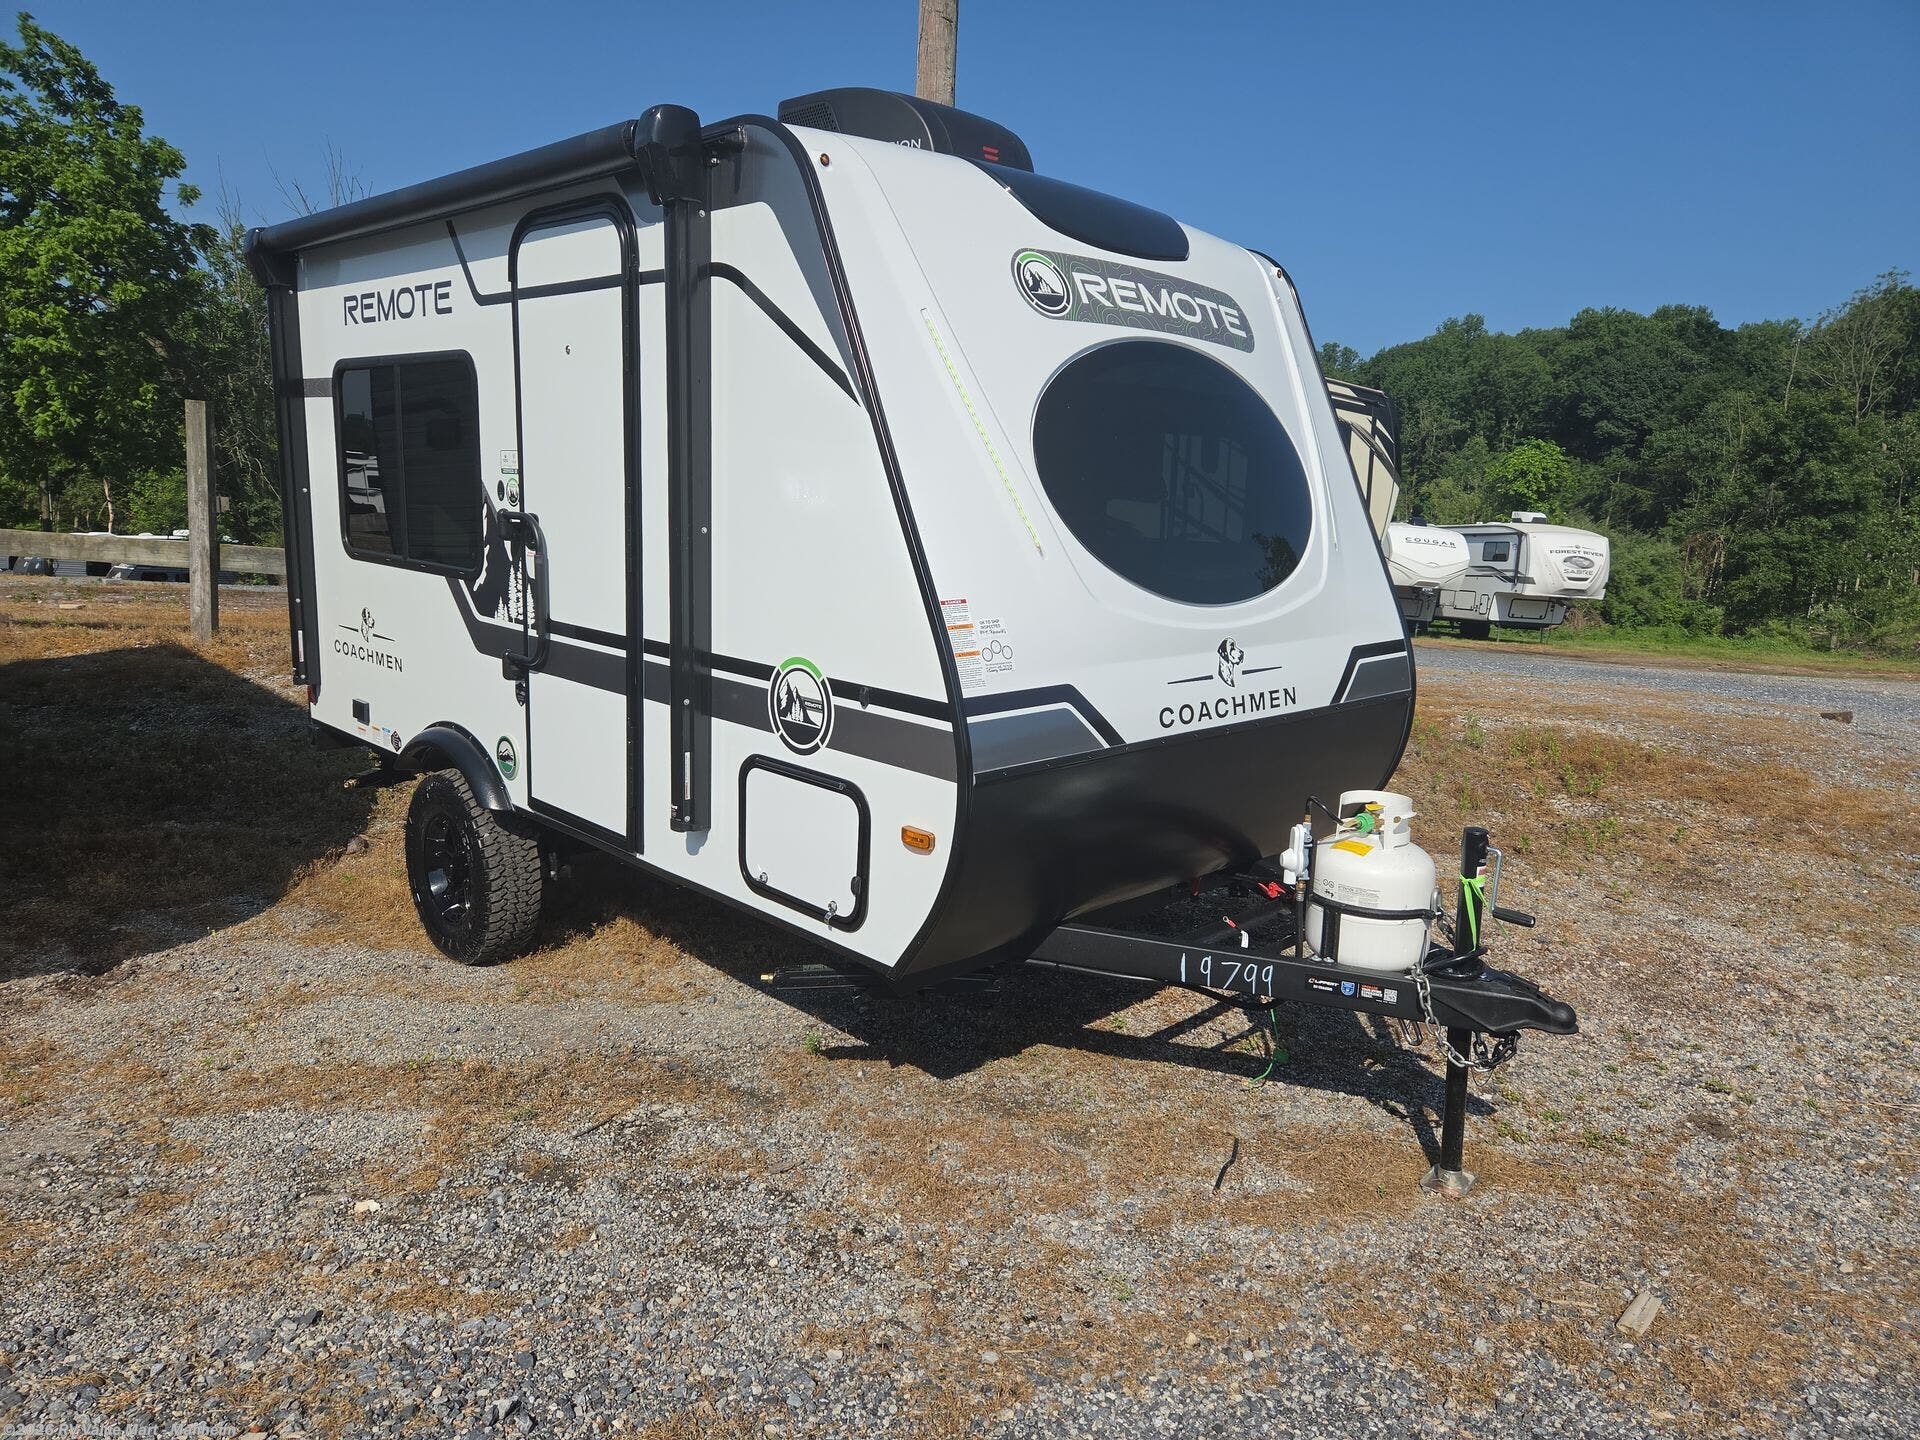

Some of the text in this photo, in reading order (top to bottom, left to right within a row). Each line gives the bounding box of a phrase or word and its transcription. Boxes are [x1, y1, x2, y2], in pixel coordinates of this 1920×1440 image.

[344, 280, 452, 326] REMOTE
[1072, 271, 1247, 338] REMOTE
[1405, 537, 1456, 547] COUGAR
[1583, 550, 1604, 558] RIVER
[334, 639, 402, 672] COACHMEN
[1159, 686, 1297, 729] COACHMEN
[1180, 952, 1274, 997] 19799
